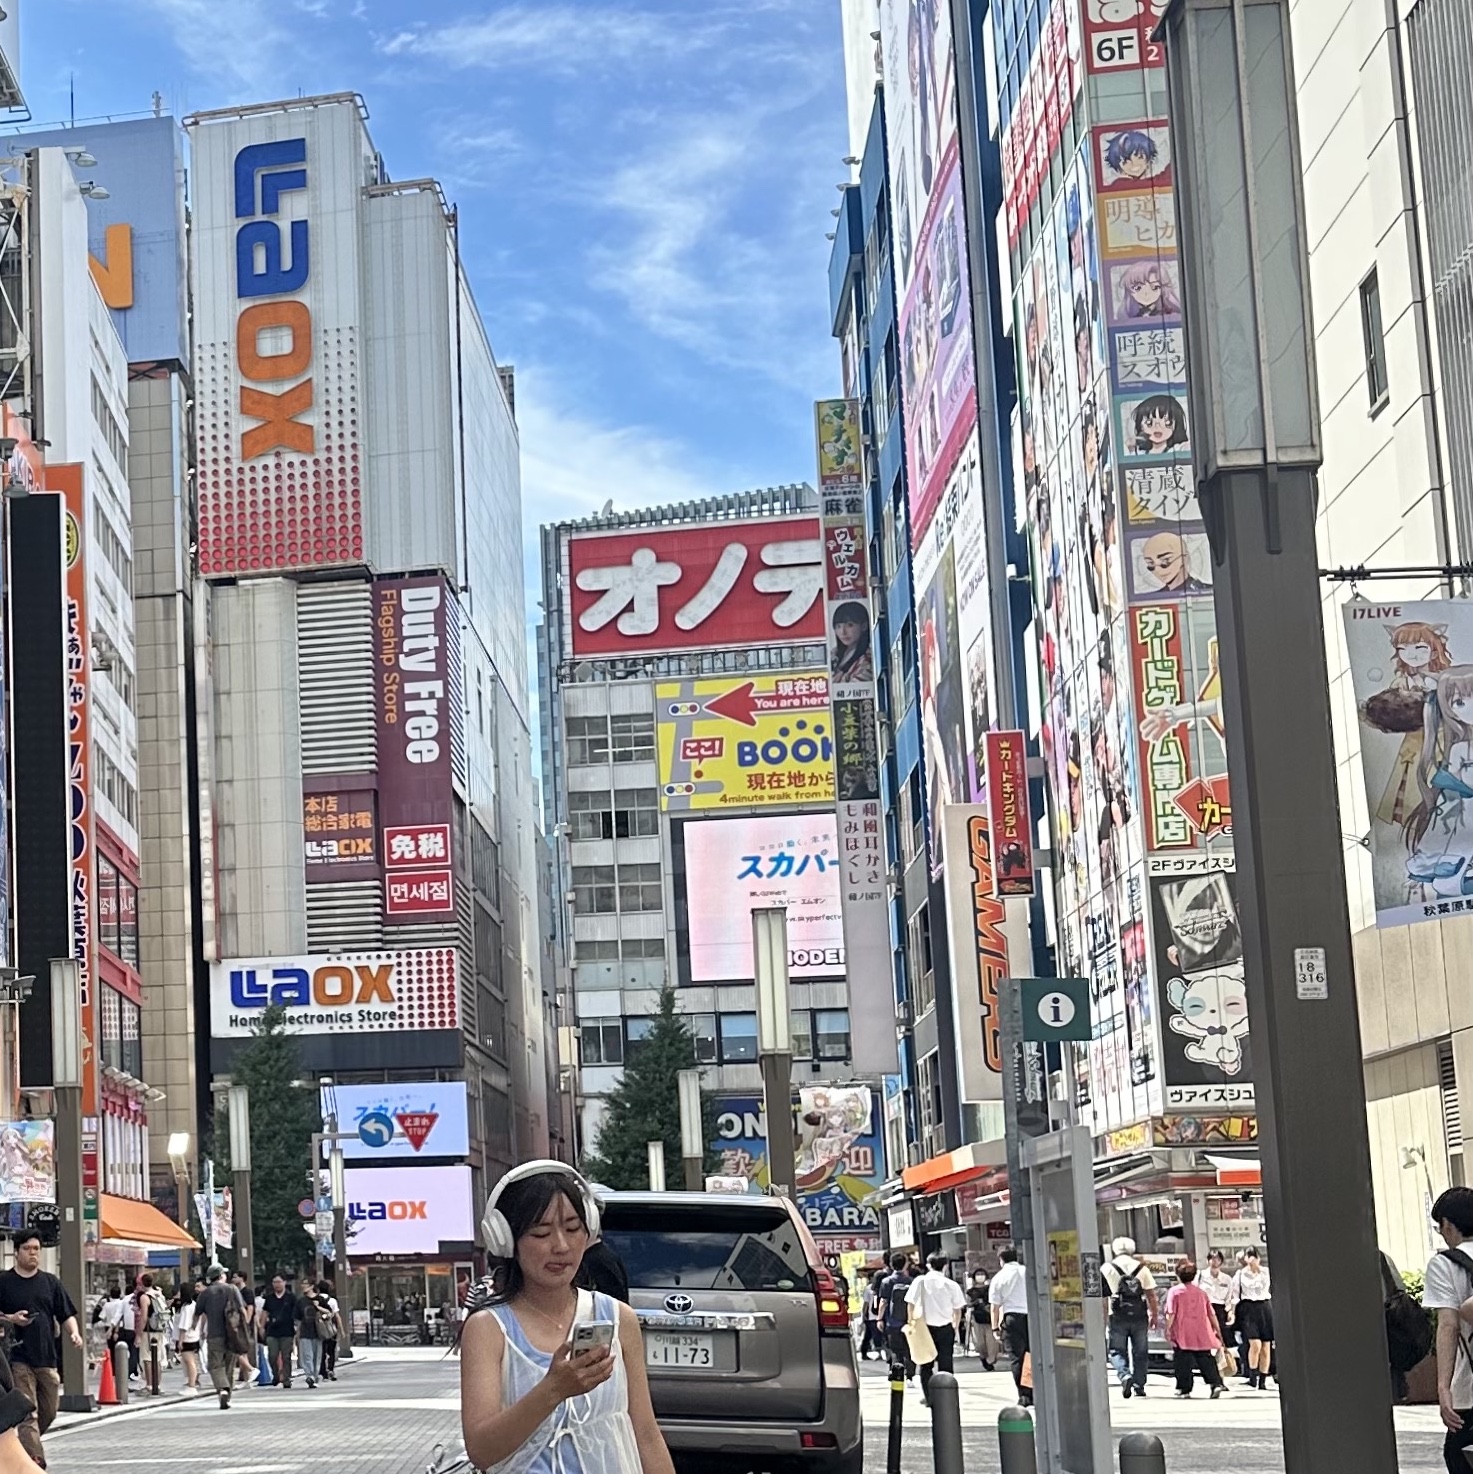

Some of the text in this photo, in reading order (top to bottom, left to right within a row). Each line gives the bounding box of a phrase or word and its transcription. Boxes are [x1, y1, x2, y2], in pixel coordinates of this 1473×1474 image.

[1096, 36, 1134, 62] 6F
[1353, 605, 1401, 621] 17LIVE
[378, 589, 400, 724] Flagship Store
[399, 585, 444, 764] Duty Free
[777, 677, 828, 696] 現在地
[754, 698, 777, 710] You
[780, 697, 804, 707] are
[685, 740, 721, 757] ここ!
[304, 795, 338, 814] 本店
[767, 791, 792, 801] walk
[794, 790, 821, 800] from
[305, 811, 373, 832] 総合家電
[390, 832, 446, 860] 免税
[390, 880, 449, 904] 면세점
[1298, 962, 1315, 972] 18
[1298, 972, 1325, 984] 316
[358, 1009, 398, 1024] Store
[408, 1127, 428, 1136] STOP
[682, 1335, 699, 1346] 334
[664, 1346, 710, 1365] 11-73
